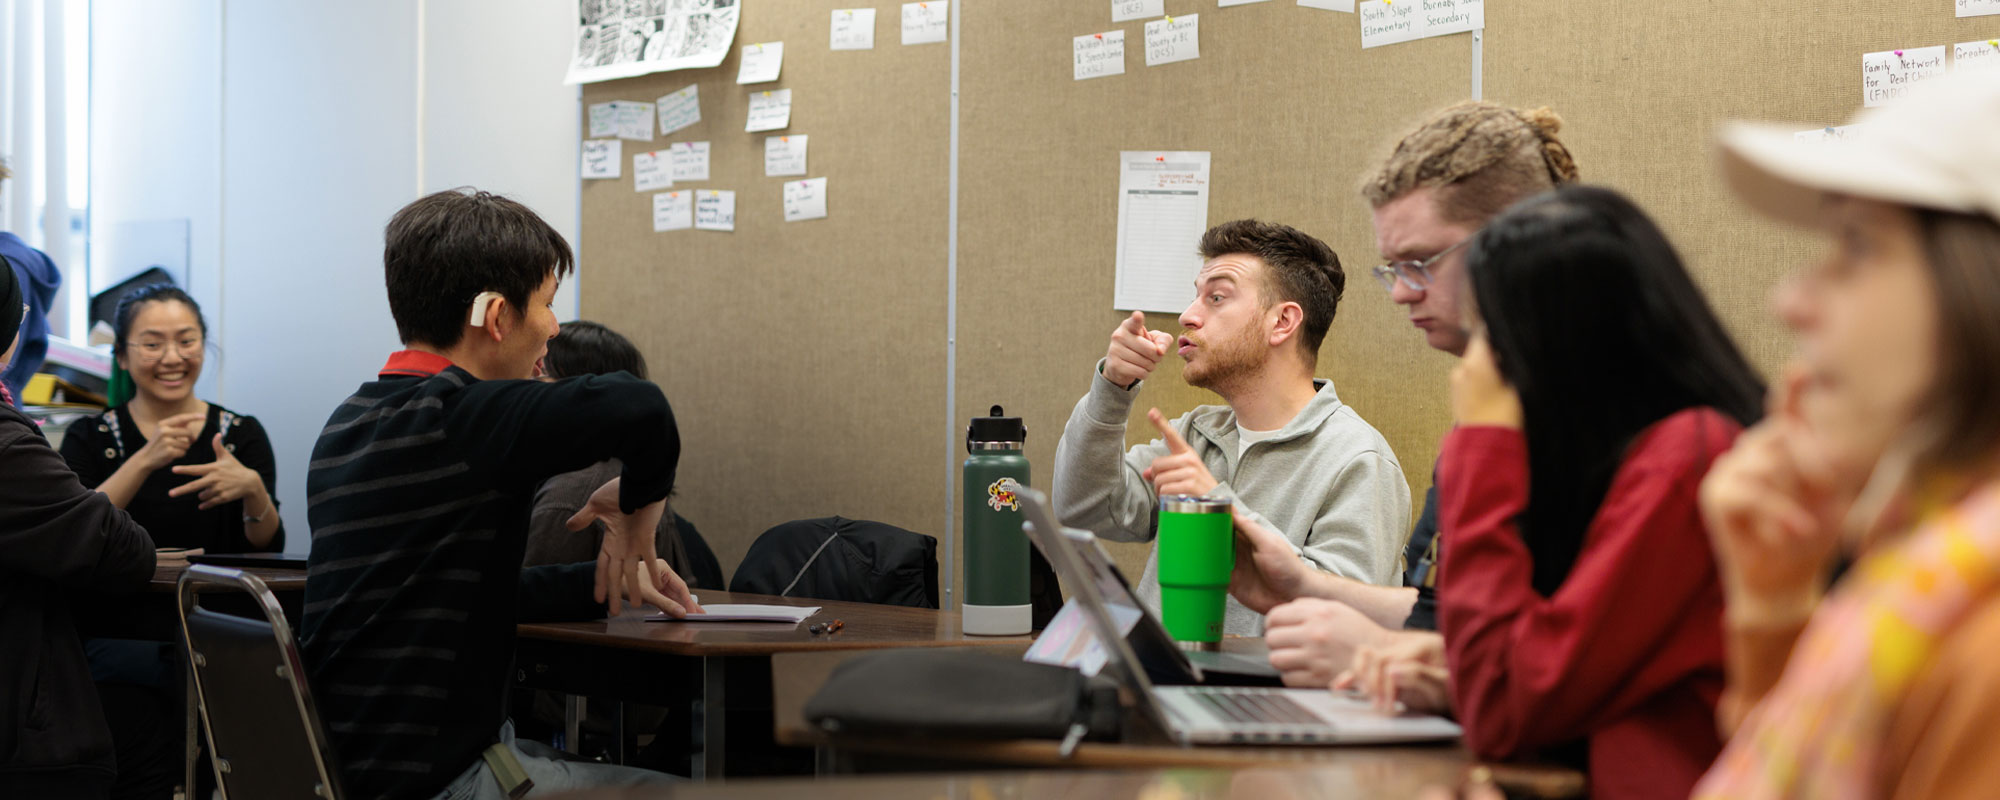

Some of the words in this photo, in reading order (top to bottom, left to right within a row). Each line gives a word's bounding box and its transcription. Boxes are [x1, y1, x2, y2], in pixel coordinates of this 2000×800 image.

[1362, 8, 1385, 22] South
[1391, 5, 1412, 17] Slope
[1426, 11, 1470, 27] Secondary
[1363, 19, 1411, 37] Elementary
[1954, 46, 1990, 60] Greater
[1864, 59, 1891, 75] Family
[1900, 56, 1940, 71] Network
[1866, 76, 1880, 88] for
[1889, 72, 1908, 85] Deaf
